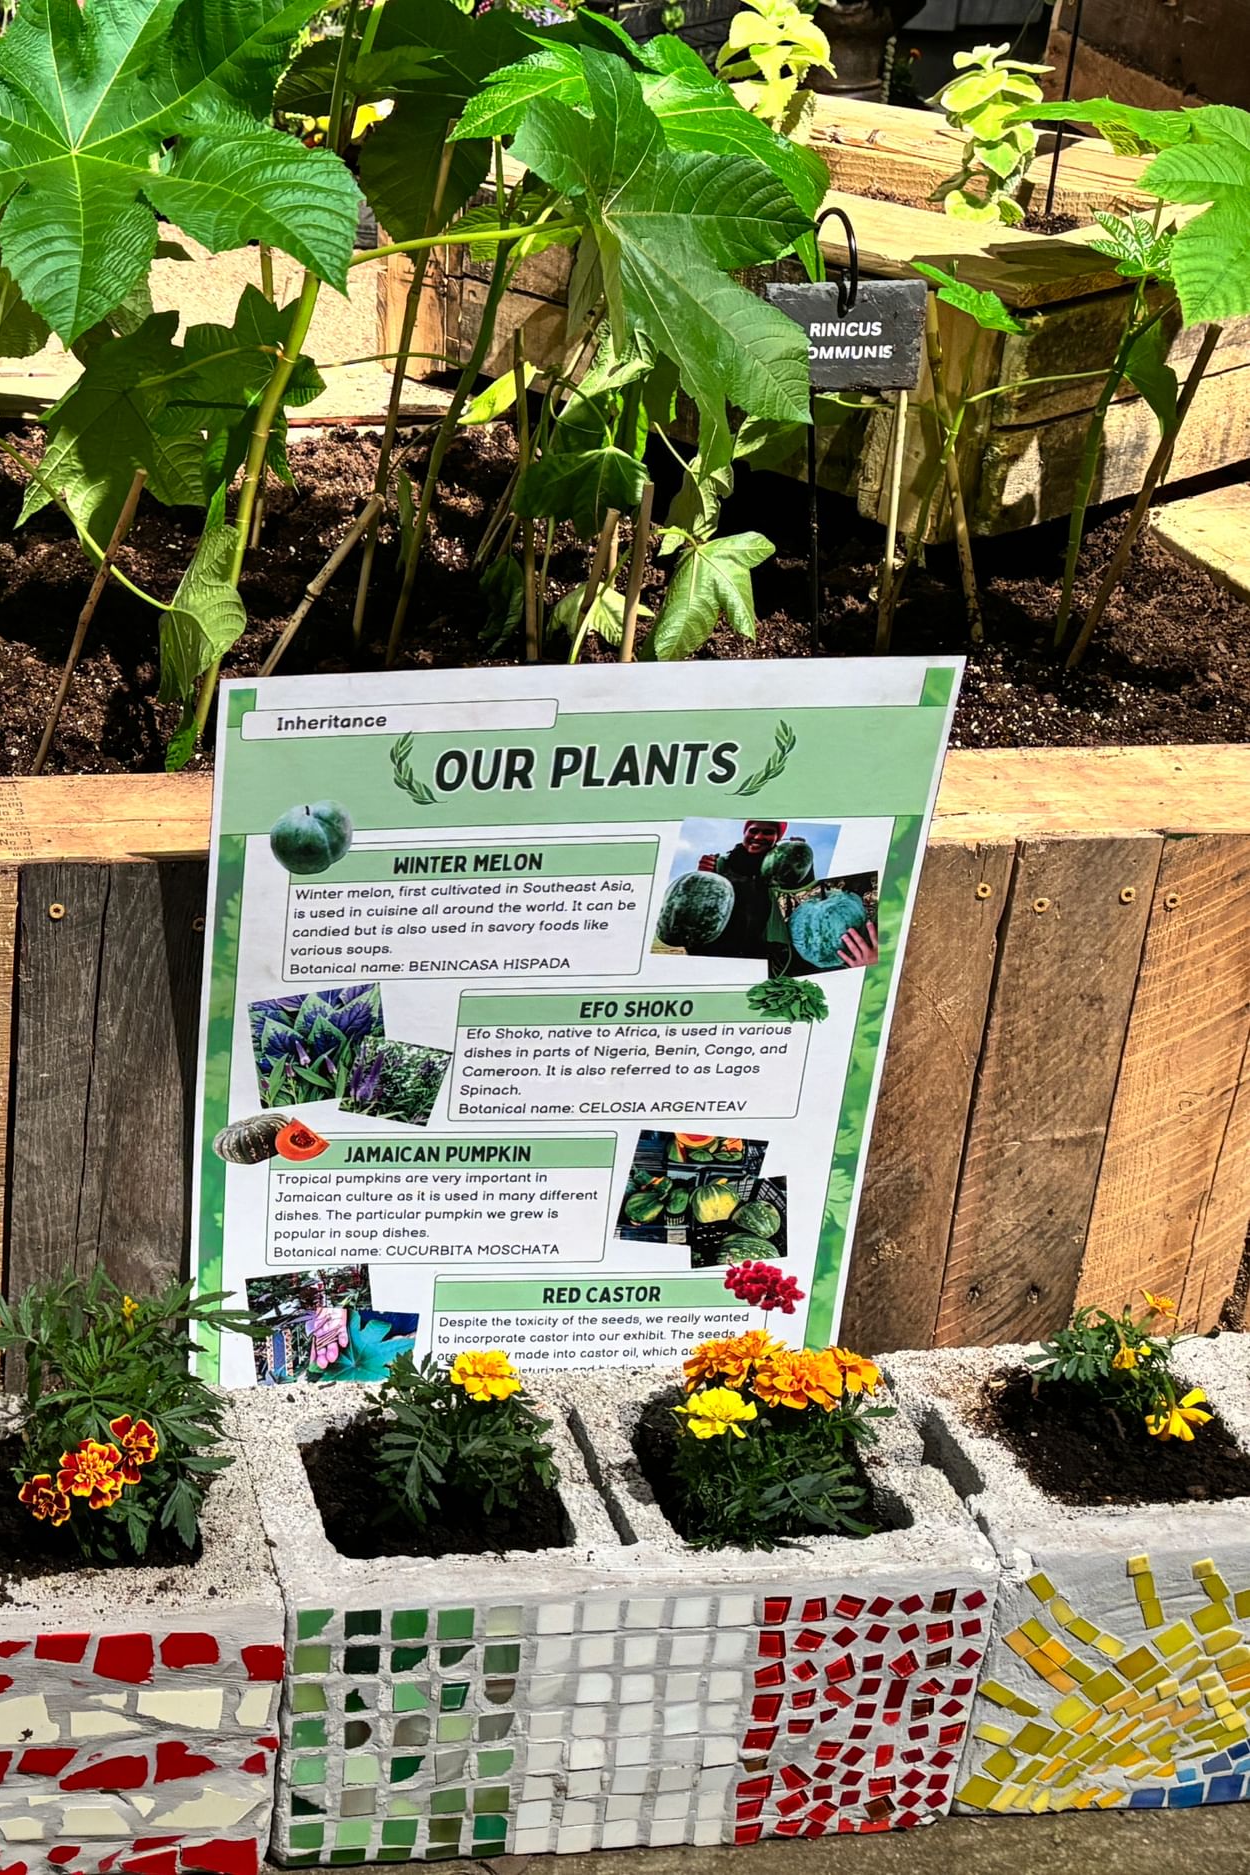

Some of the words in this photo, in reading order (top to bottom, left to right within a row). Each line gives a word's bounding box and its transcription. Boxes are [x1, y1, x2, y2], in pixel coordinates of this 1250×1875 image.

[810, 322, 882, 336] RINICUS
[808, 345, 892, 360] OMMUNIS
[277, 714, 387, 731] Inheritance
[435, 748, 534, 792] OUR
[550, 742, 739, 788] PLANTS
[393, 855, 467, 874] WINTER
[473, 852, 543, 872] MELON
[295, 889, 344, 900] Winter
[347, 887, 394, 899] melon,
[399, 886, 426, 897] first
[430, 883, 501, 896] cultivated
[506, 885, 518, 894] in
[523, 882, 596, 894] Southeast
[600, 880, 634, 893] Asia,
[292, 926, 350, 938] candied
[354, 925, 377, 936] but
[381, 924, 393, 935] is
[397, 924, 427, 935] also
[431, 922, 467, 934] used
[471, 922, 484, 932] in
[488, 923, 535, 934] savory
[539, 920, 580, 931] foods
[584, 919, 609, 930] like
[290, 962, 356, 975] Botanical
[360, 964, 404, 972] name:
[409, 959, 499, 972] BENINCASA
[503, 958, 570, 970] HISPADA
[580, 1001, 618, 1018] EFO
[624, 1000, 694, 1018] SHOKO
[466, 1028, 491, 1040] Efo
[495, 1028, 543, 1040] Shoko,
[548, 1028, 592, 1038] native
[597, 1027, 611, 1038] to
[614, 1026, 660, 1038] Africa,
[665, 1026, 677, 1037] is
[681, 1025, 718, 1036] used
[722, 1027, 734, 1036] in
[739, 1024, 792, 1036] various
[464, 1047, 512, 1058] dishes
[516, 1047, 529, 1058] in
[533, 1047, 570, 1060] parts
[575, 1046, 590, 1057] of
[594, 1045, 650, 1059] Nigeria,
[655, 1044, 700, 1057] Benin,
[704, 1044, 755, 1058] Congo,
[760, 1043, 788, 1054] and
[459, 1103, 526, 1114] Botanical
[530, 1105, 574, 1114] name:
[579, 1102, 646, 1114] CELOSIA
[650, 1100, 747, 1112] ARGENTEAV
[344, 1146, 440, 1163] JAMAICAN
[445, 1146, 531, 1162] PUMPKIN
[276, 1174, 332, 1187] Tropical
[336, 1173, 401, 1186] pumpkins
[405, 1175, 428, 1183] are
[432, 1175, 462, 1186] very
[465, 1172, 531, 1185] important
[535, 1172, 547, 1182] in
[274, 1210, 321, 1221] dishes.
[326, 1209, 352, 1220] The
[356, 1209, 421, 1222] particular
[425, 1209, 482, 1222] pumpkin
[486, 1211, 506, 1219] we
[510, 1210, 544, 1222] grew
[547, 1208, 558, 1219] is
[274, 1246, 336, 1258] Botanical
[340, 1248, 381, 1256] name:
[386, 1245, 473, 1256] CUCURBITA
[478, 1244, 560, 1255] MOSCHATA
[542, 1287, 581, 1304] RED
[586, 1286, 661, 1303] CASTOR
[439, 1317, 488, 1329] Despite
[492, 1317, 512, 1326] the
[515, 1316, 559, 1328] toxicity
[562, 1315, 574, 1325] of
[578, 1315, 598, 1325] the
[601, 1314, 642, 1326] seeds,
[646, 1316, 664, 1324] we
[667, 1313, 701, 1325] really
[704, 1312, 749, 1322] wanted
